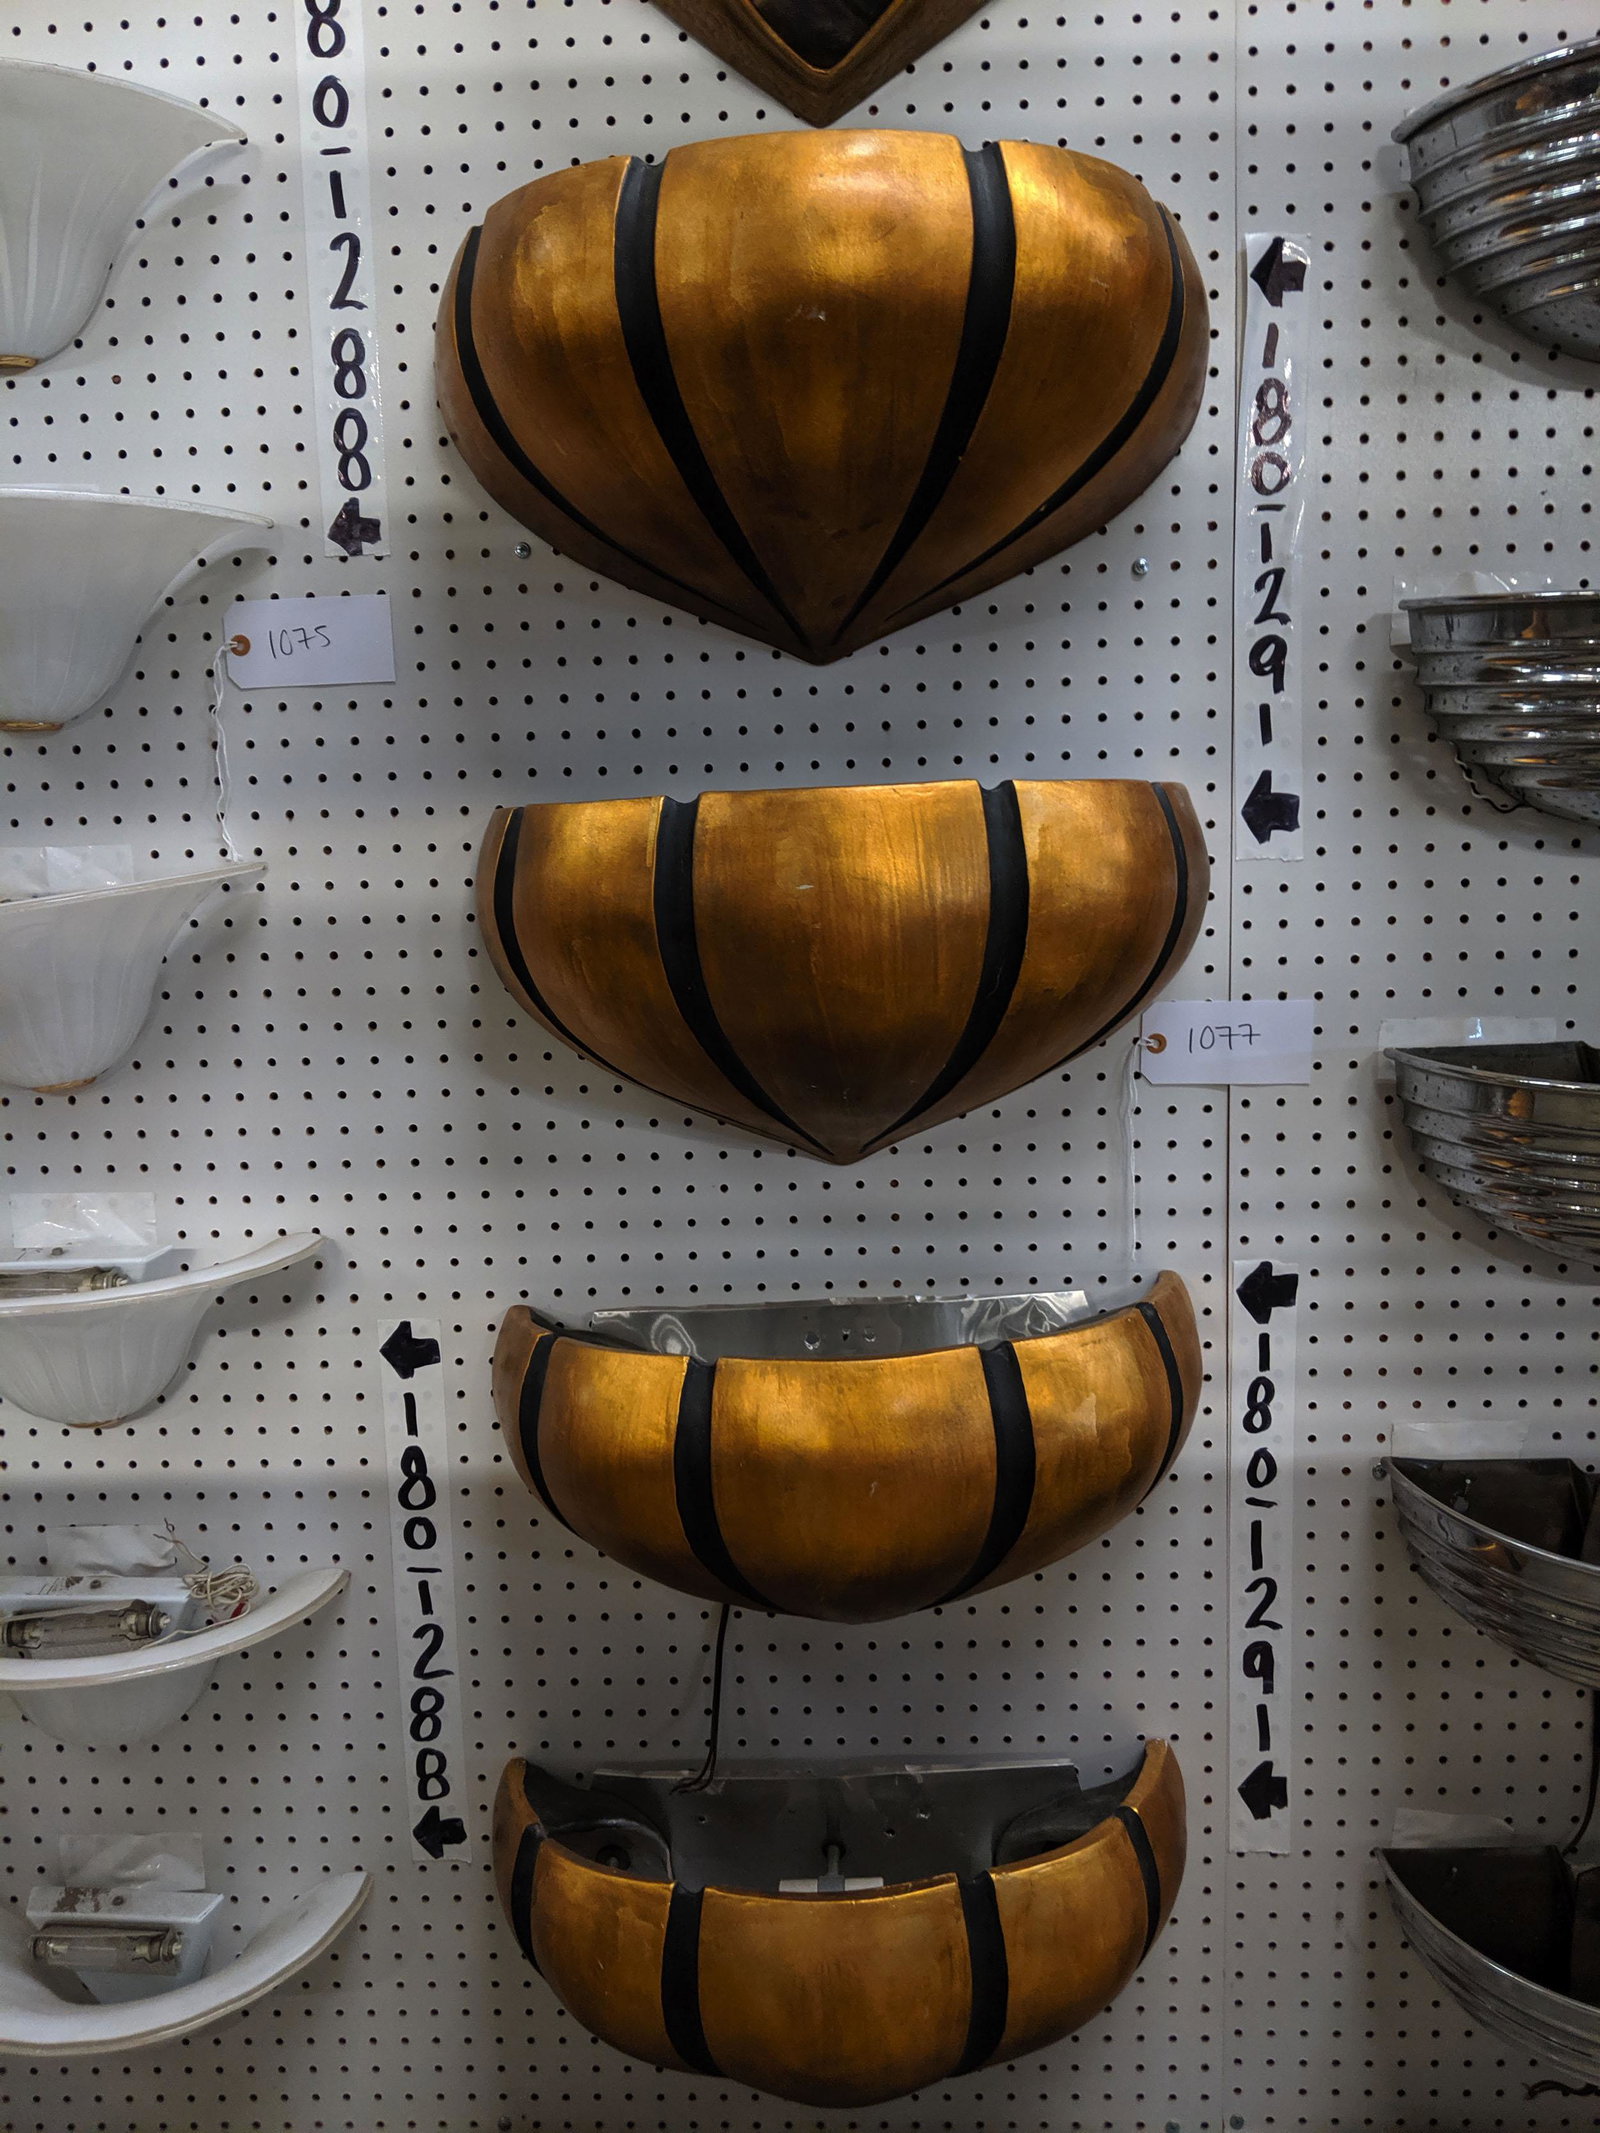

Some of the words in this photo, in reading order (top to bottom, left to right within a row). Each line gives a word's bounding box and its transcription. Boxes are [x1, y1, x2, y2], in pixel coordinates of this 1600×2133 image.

[268, 625, 331, 659] 1075
[1188, 1023, 1261, 1053] 1077
[1242, 1332, 1283, 1752] 180-1291
